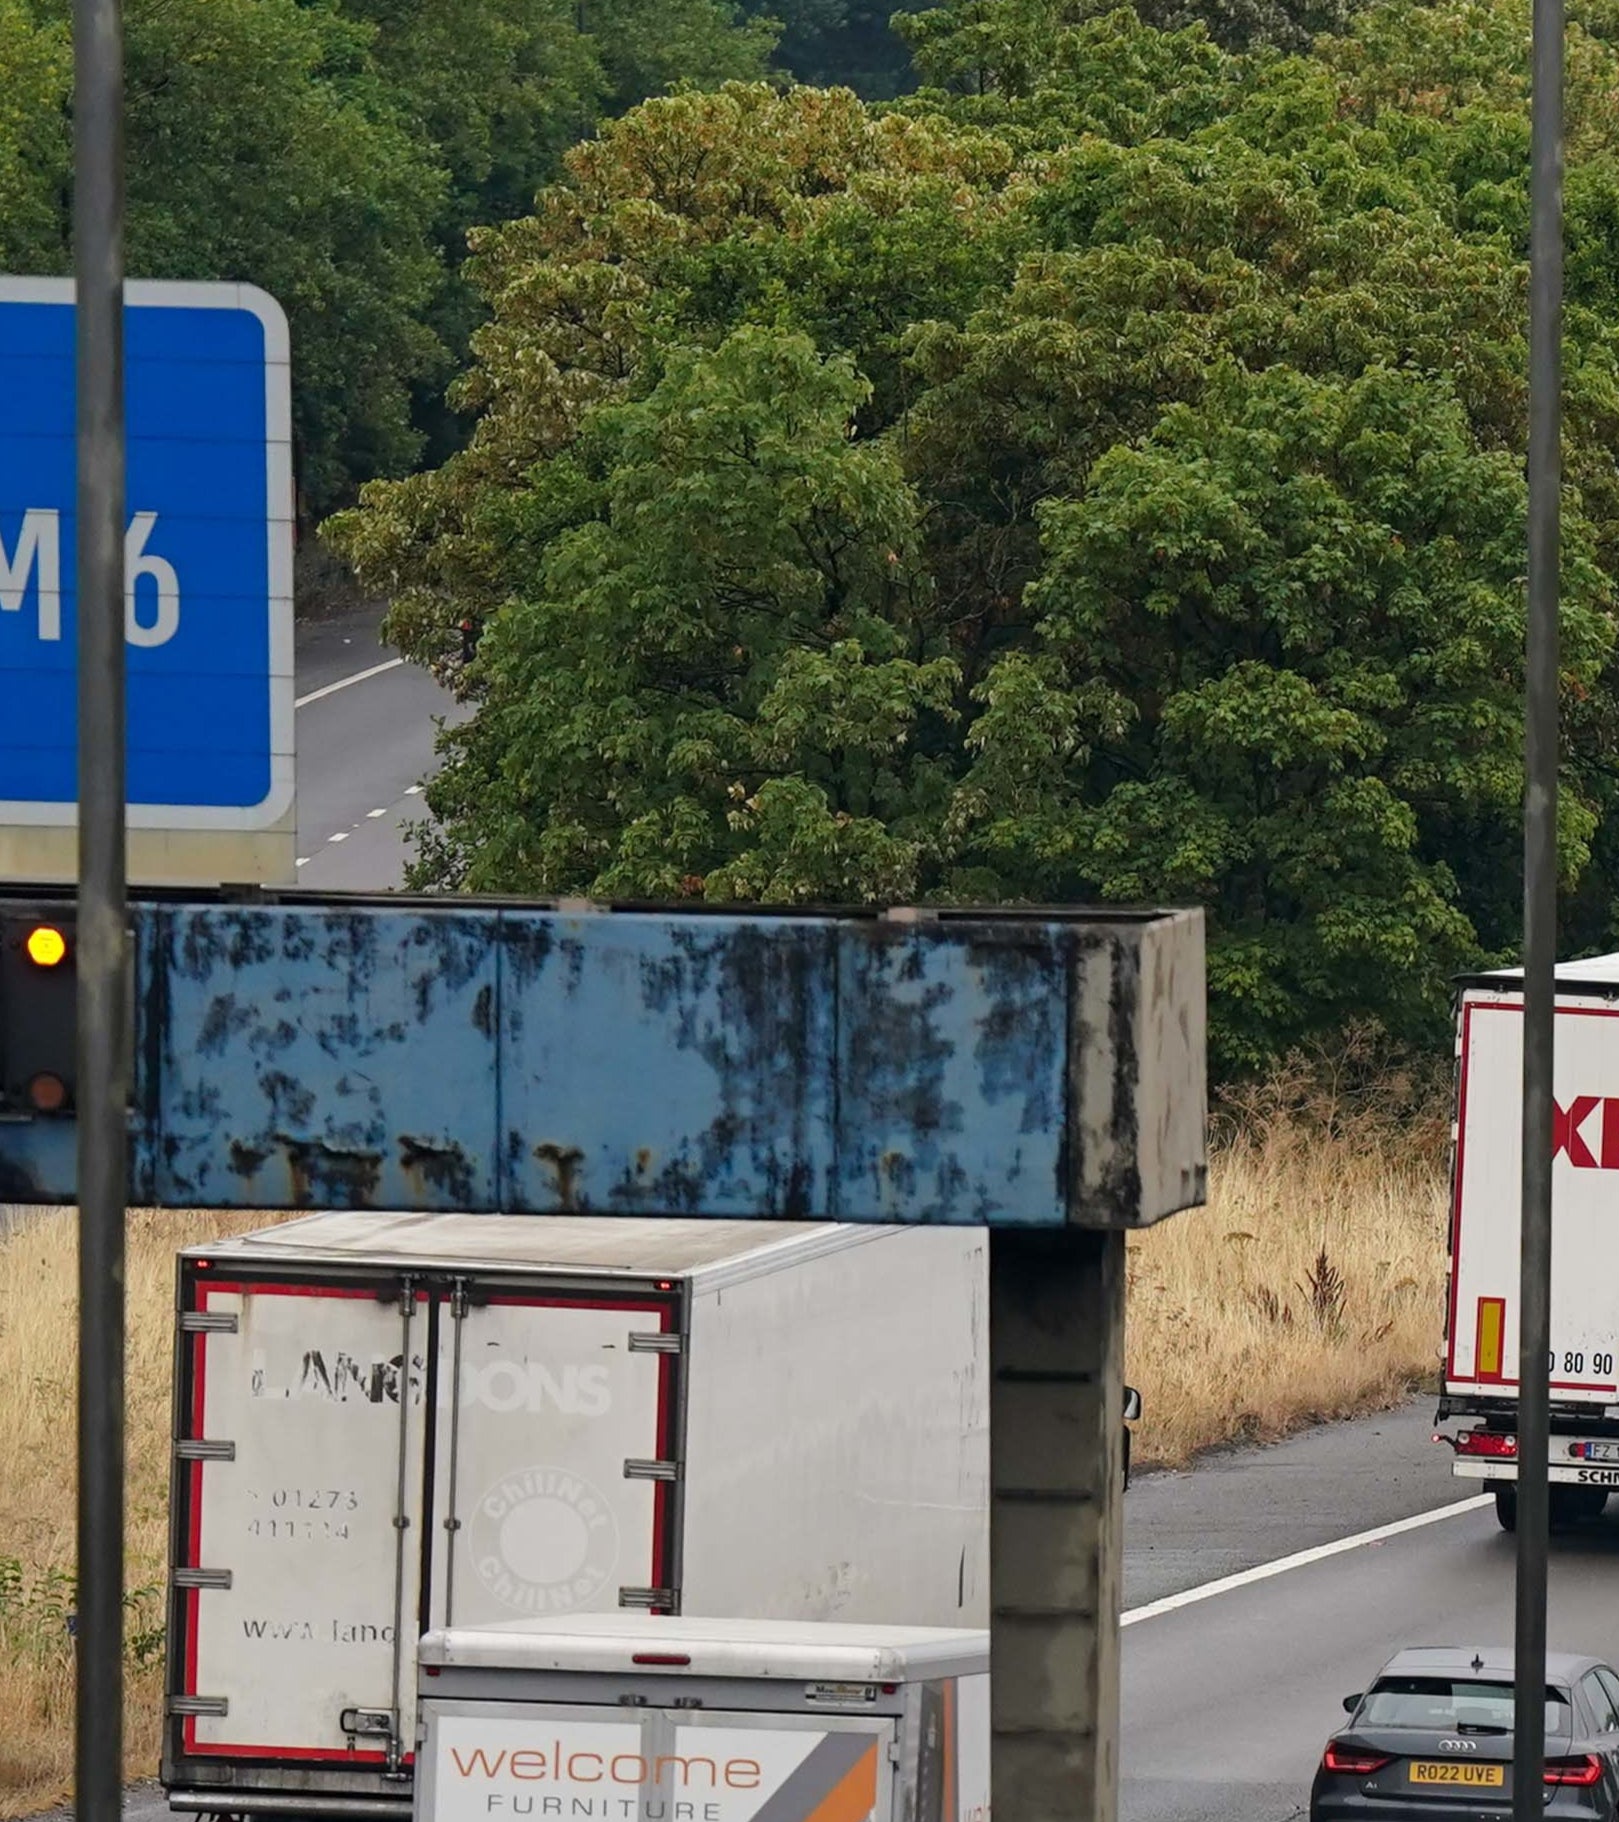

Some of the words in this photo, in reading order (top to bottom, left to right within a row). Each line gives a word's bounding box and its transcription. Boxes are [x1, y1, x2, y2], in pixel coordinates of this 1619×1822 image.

[1564, 1352, 1584, 1374] 80
[1592, 1353, 1613, 1375] 90
[451, 1740, 762, 1789] welcome
[1417, 1764, 1462, 1780] RO22
[1464, 1767, 1496, 1783] UVE
[487, 1794, 721, 1822] FURNITURE
